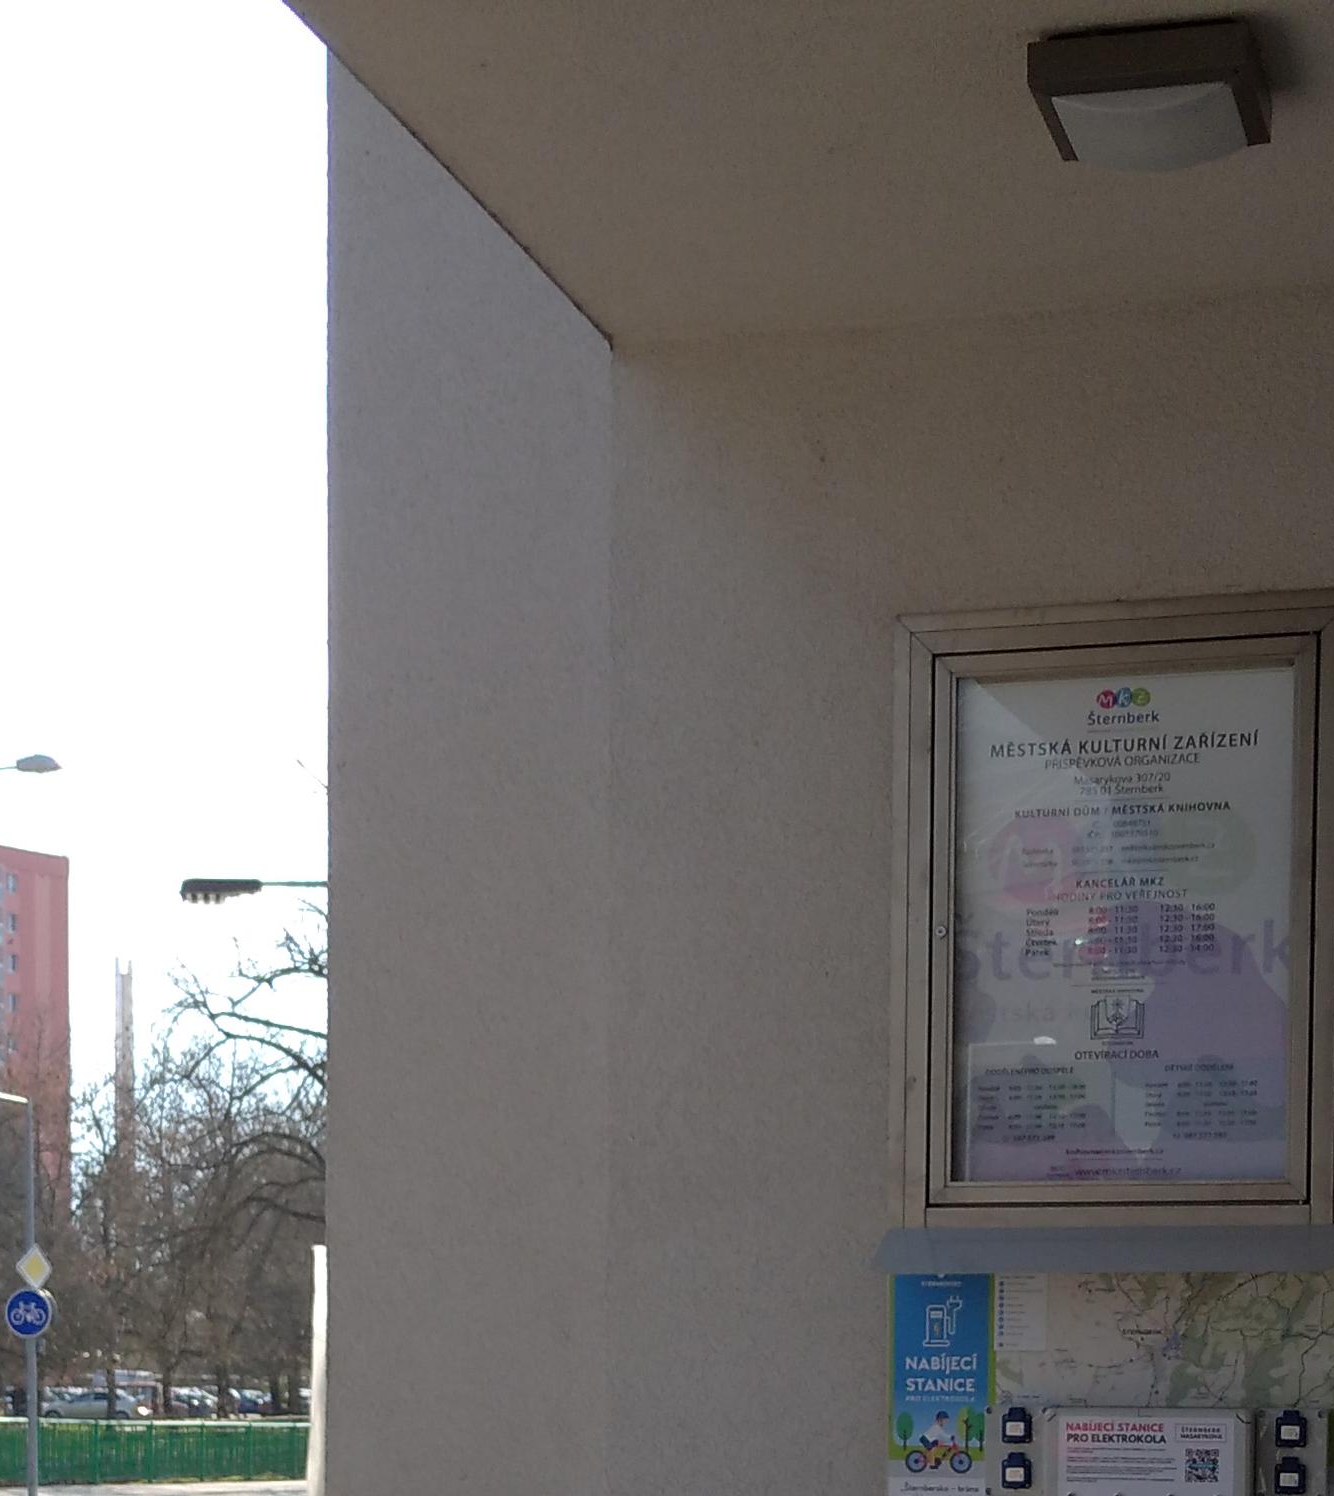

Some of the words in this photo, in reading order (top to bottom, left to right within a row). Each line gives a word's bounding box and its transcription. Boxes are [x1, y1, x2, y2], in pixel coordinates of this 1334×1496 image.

[1087, 710, 1160, 726] Šternberk
[990, 740, 1072, 759] MĚSTSKÁ
[1079, 734, 1167, 754] KULTURNÍ
[1174, 729, 1259, 750] ZAŘÍZENÍ
[1124, 753, 1200, 766] ORGANIZACE
[1168, 800, 1230, 813] KNIHOVNA
[905, 1353, 977, 1374] NABÍJECÍ
[906, 1378, 975, 1392] STANICE
[1066, 1420, 1115, 1432] NABÍJECÍ
[1117, 1423, 1164, 1433] STANICE
[1066, 1433, 1088, 1443] PRO
[1091, 1434, 1167, 1445] ELEKTROKOLA
